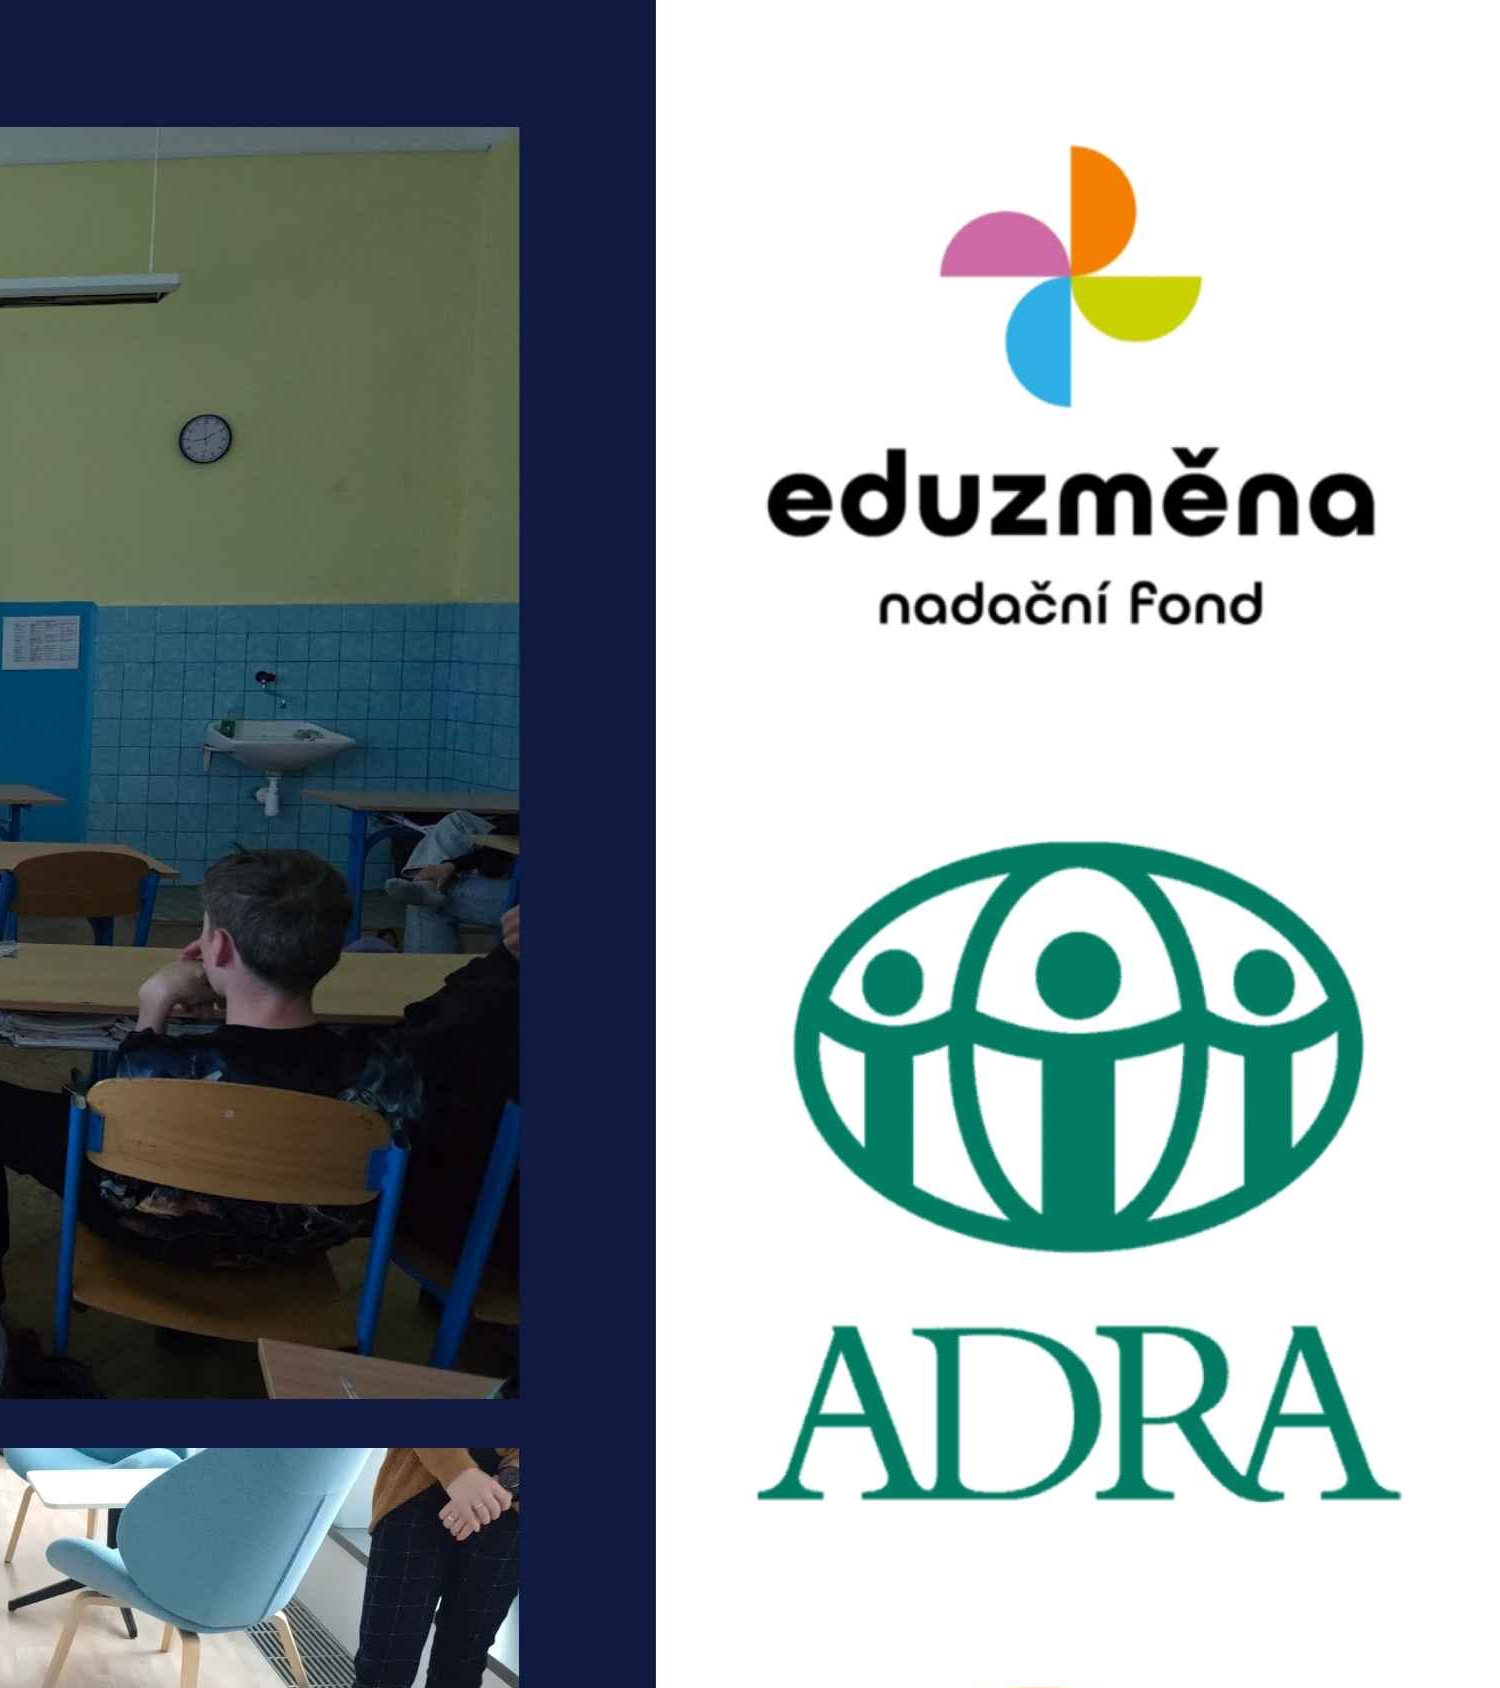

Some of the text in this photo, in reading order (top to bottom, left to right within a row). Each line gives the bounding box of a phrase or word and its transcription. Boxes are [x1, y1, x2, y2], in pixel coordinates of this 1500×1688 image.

[767, 446, 1375, 538] eduzměna
[879, 580, 1263, 626] nadační fond
[757, 1325, 1402, 1503] ADRA
